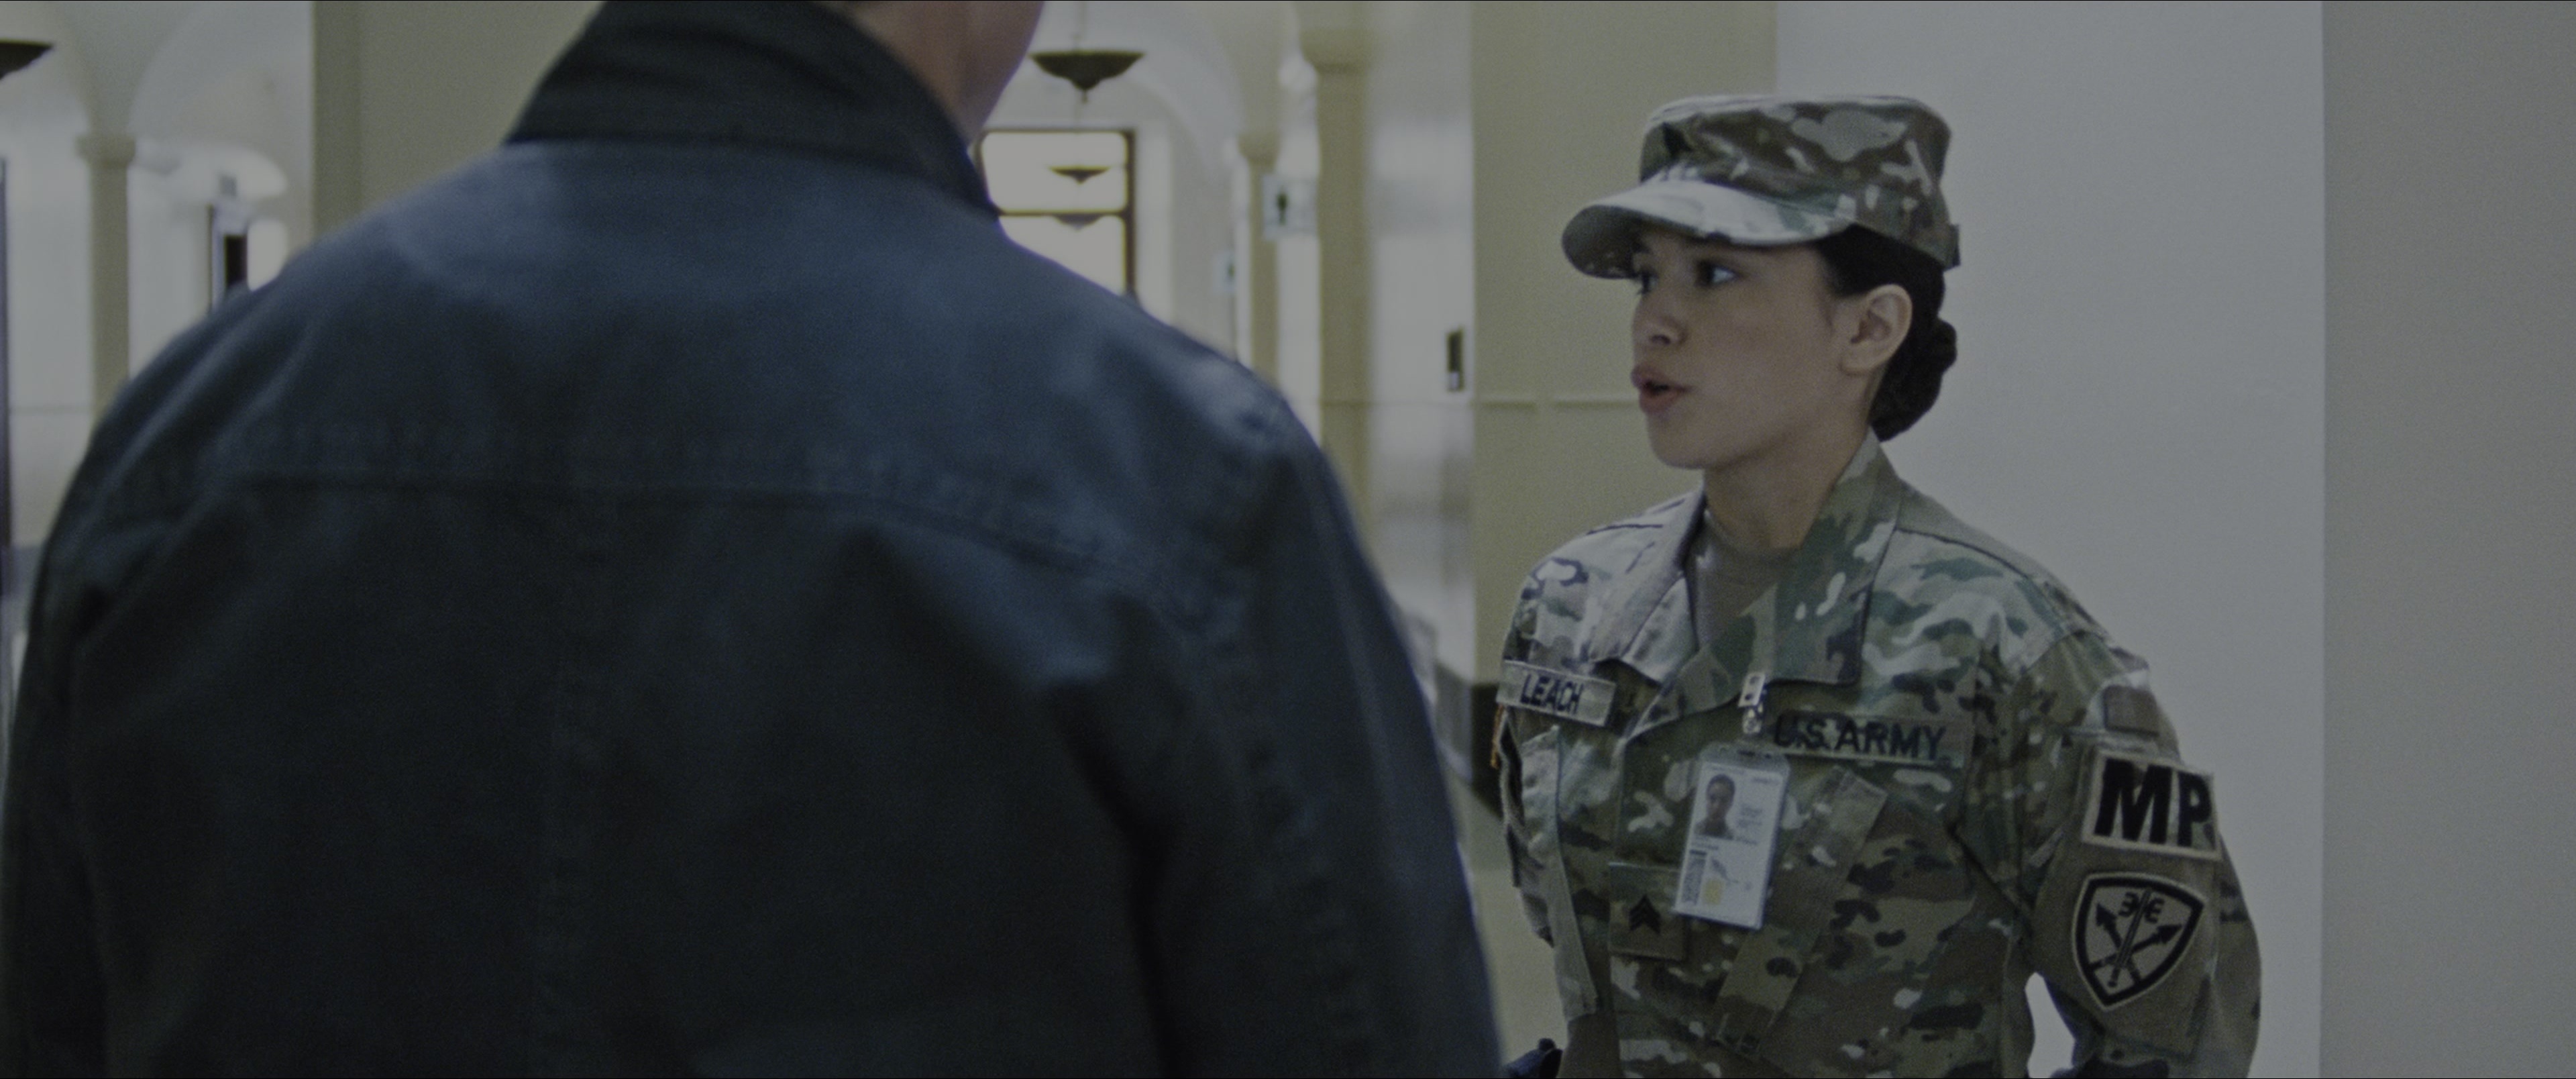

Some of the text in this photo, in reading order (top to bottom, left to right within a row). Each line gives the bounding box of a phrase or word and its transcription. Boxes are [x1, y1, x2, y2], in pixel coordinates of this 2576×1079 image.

[1520, 673, 1585, 715] LEACH
[1833, 719, 1946, 760] ARMY
[2094, 758, 2212, 847] MP
